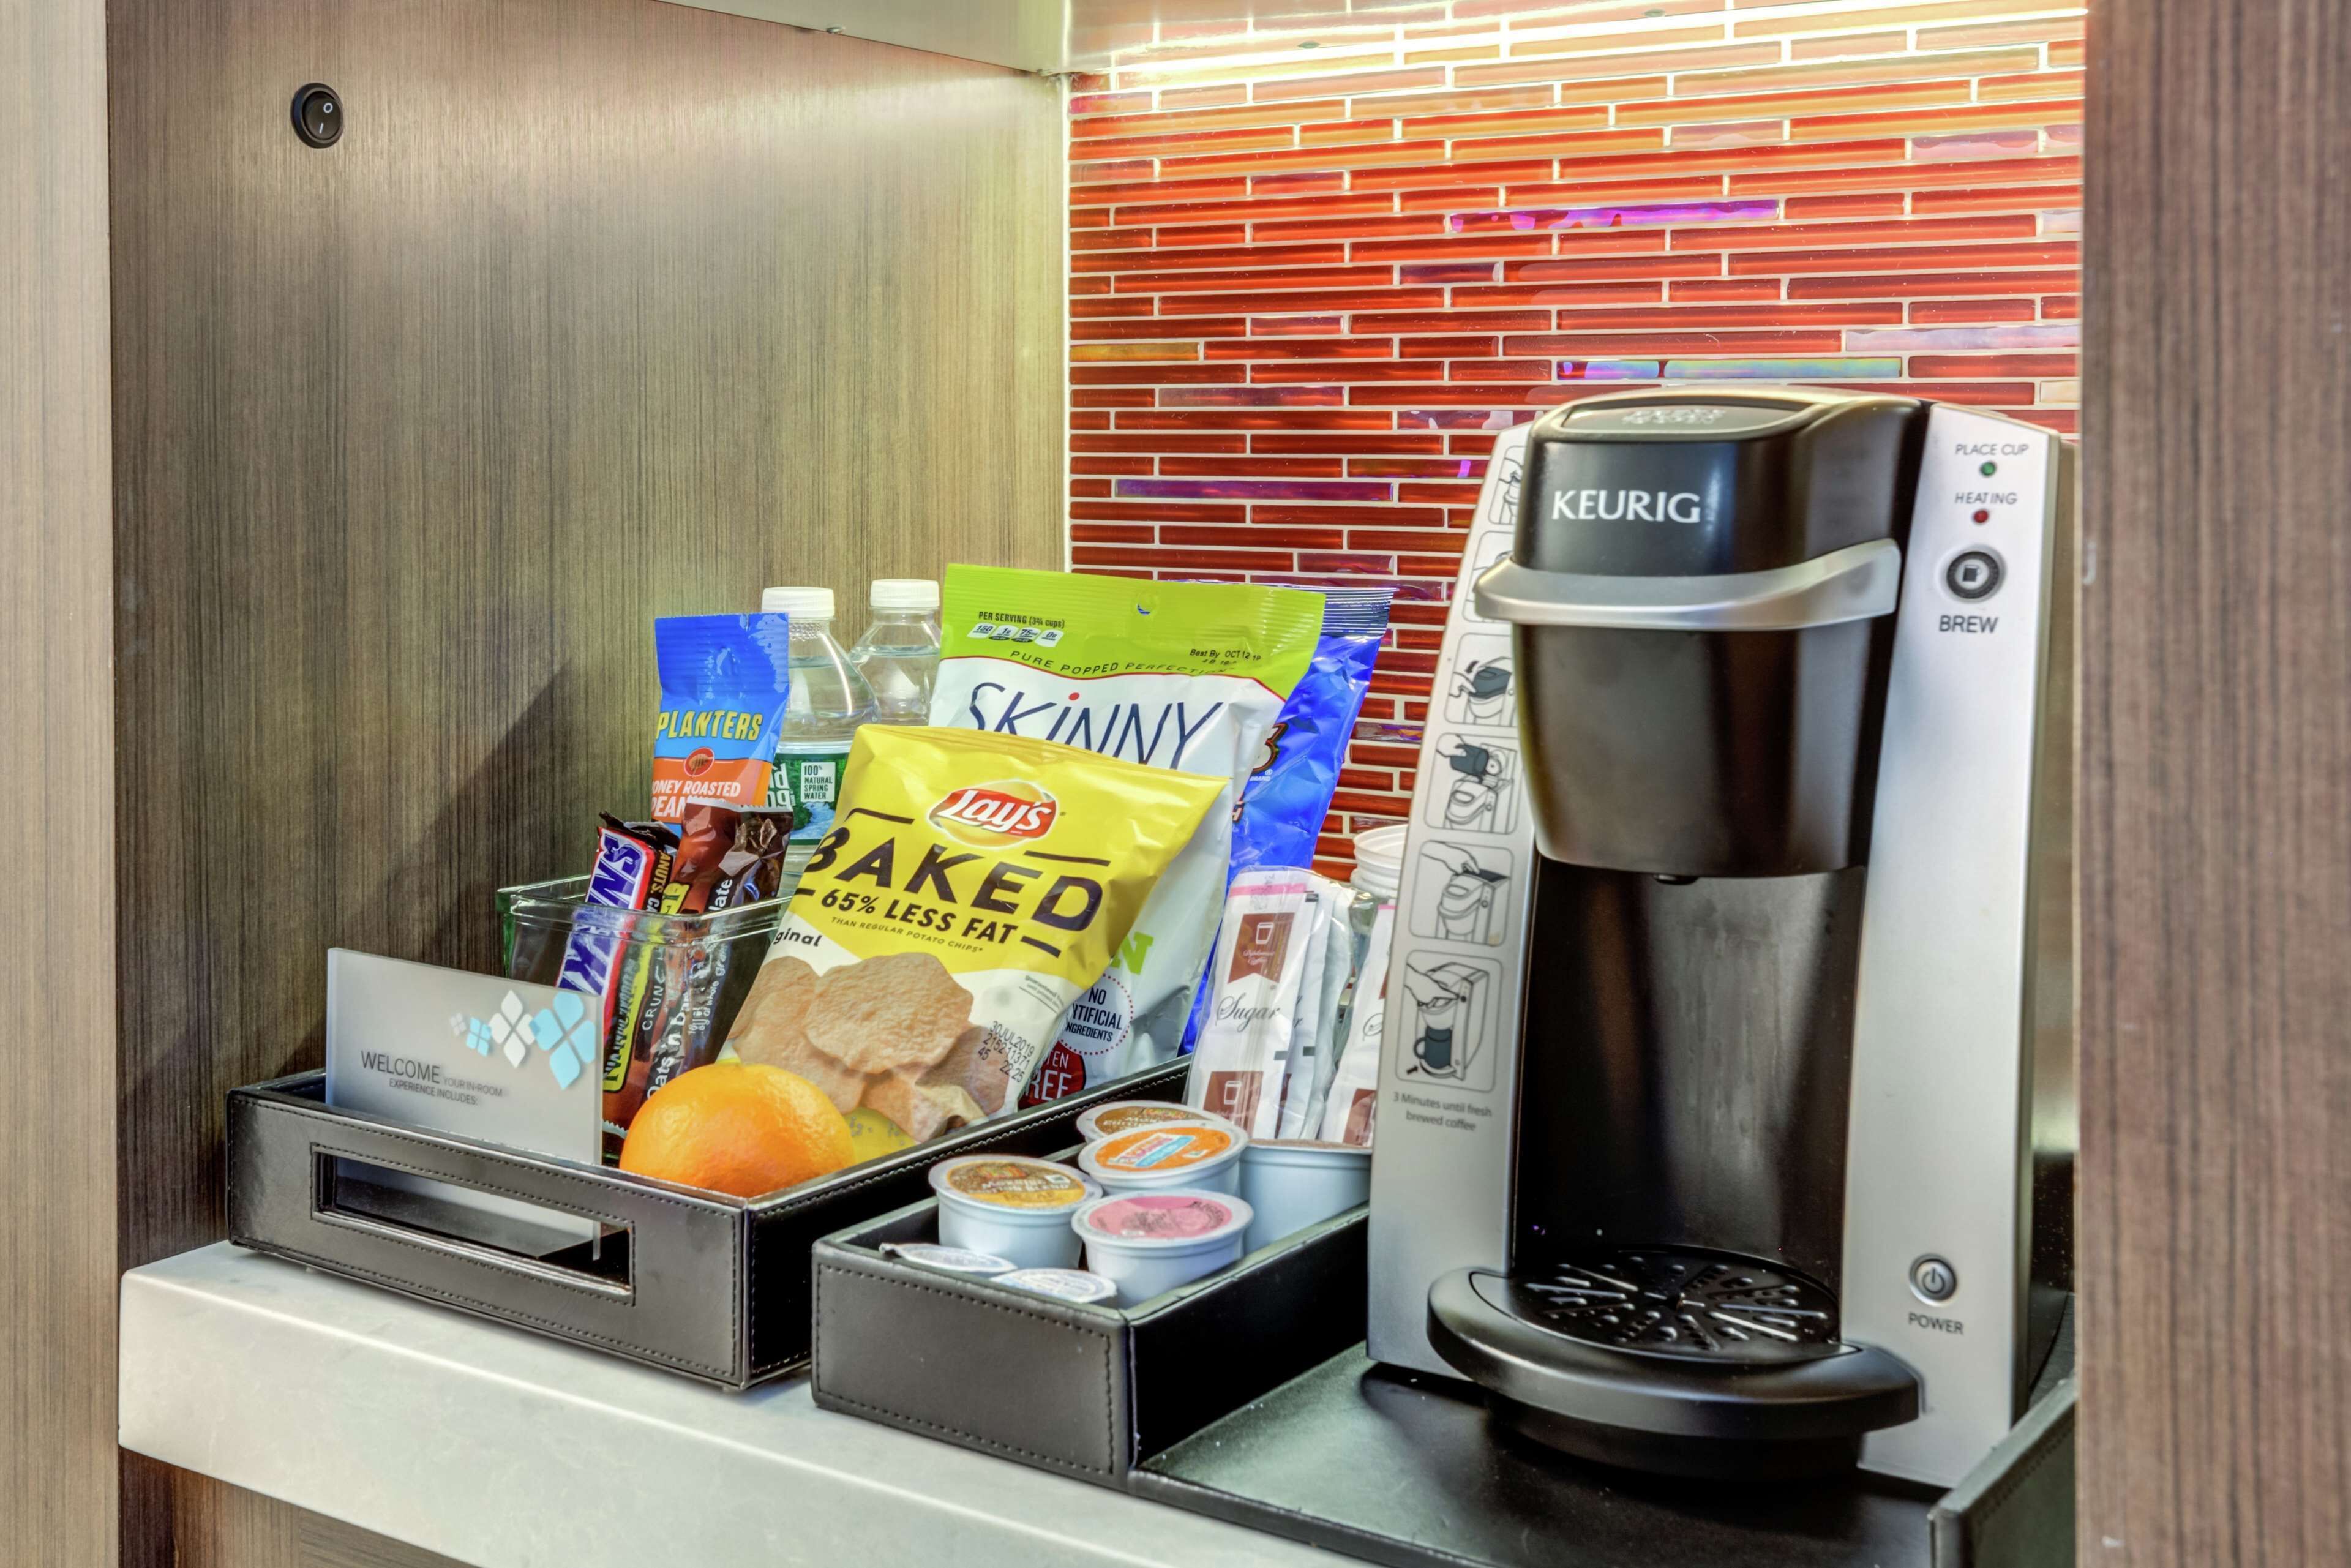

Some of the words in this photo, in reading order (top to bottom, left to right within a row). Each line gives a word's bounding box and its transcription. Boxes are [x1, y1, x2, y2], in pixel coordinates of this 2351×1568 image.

[1955, 443, 1997, 456] PLACE
[2001, 443, 2029, 456] CUP
[1551, 489, 1701, 523] KEURIG
[1954, 492, 2018, 505] HEATING
[978, 611, 993, 621] PER
[995, 612, 1027, 625] SERVING
[1939, 614, 1999, 634] BREW
[1010, 650, 1055, 669] PURE
[1060, 662, 1119, 675] POPPED
[1190, 648, 1207, 658] Best
[1209, 649, 1220, 659] By
[656, 710, 763, 741] PLANTERS
[651, 779, 684, 795] ONEY
[682, 780, 742, 797] ROASTED
[650, 849, 671, 895] ANUTS.
[803, 827, 1103, 932] BAKED
[709, 878, 733, 912] late
[821, 888, 880, 915] 65%
[884, 899, 957, 932] LESS
[961, 917, 1018, 945] FAT
[773, 927, 822, 947] ginal
[831, 916, 857, 928] THAN
[859, 921, 904, 936] REGULAR
[906, 930, 945, 945] POTATO
[1088, 987, 1107, 1005] NO
[1214, 992, 1281, 1033] Sugar
[989, 1020, 1035, 1058] 30JUL2019
[1065, 1022, 1113, 1043] NGREDIENTS
[978, 1046, 991, 1061] 45
[361, 1049, 441, 1084] WELCOME
[443, 1076, 465, 1088] YOUR
[465, 1080, 503, 1097] IN-ROOM
[1029, 1067, 1073, 1101] REE
[389, 1078, 435, 1097] EXPERIENCE
[1393, 1091, 1400, 1102] 3
[1401, 1093, 1441, 1109] Minutes
[1442, 1101, 1466, 1113] until
[1467, 1103, 1493, 1117] fresh
[1406, 1109, 1444, 1126] brewed
[1444, 1117, 1477, 1131] coffee
[1908, 1311, 1964, 1336] POWER
